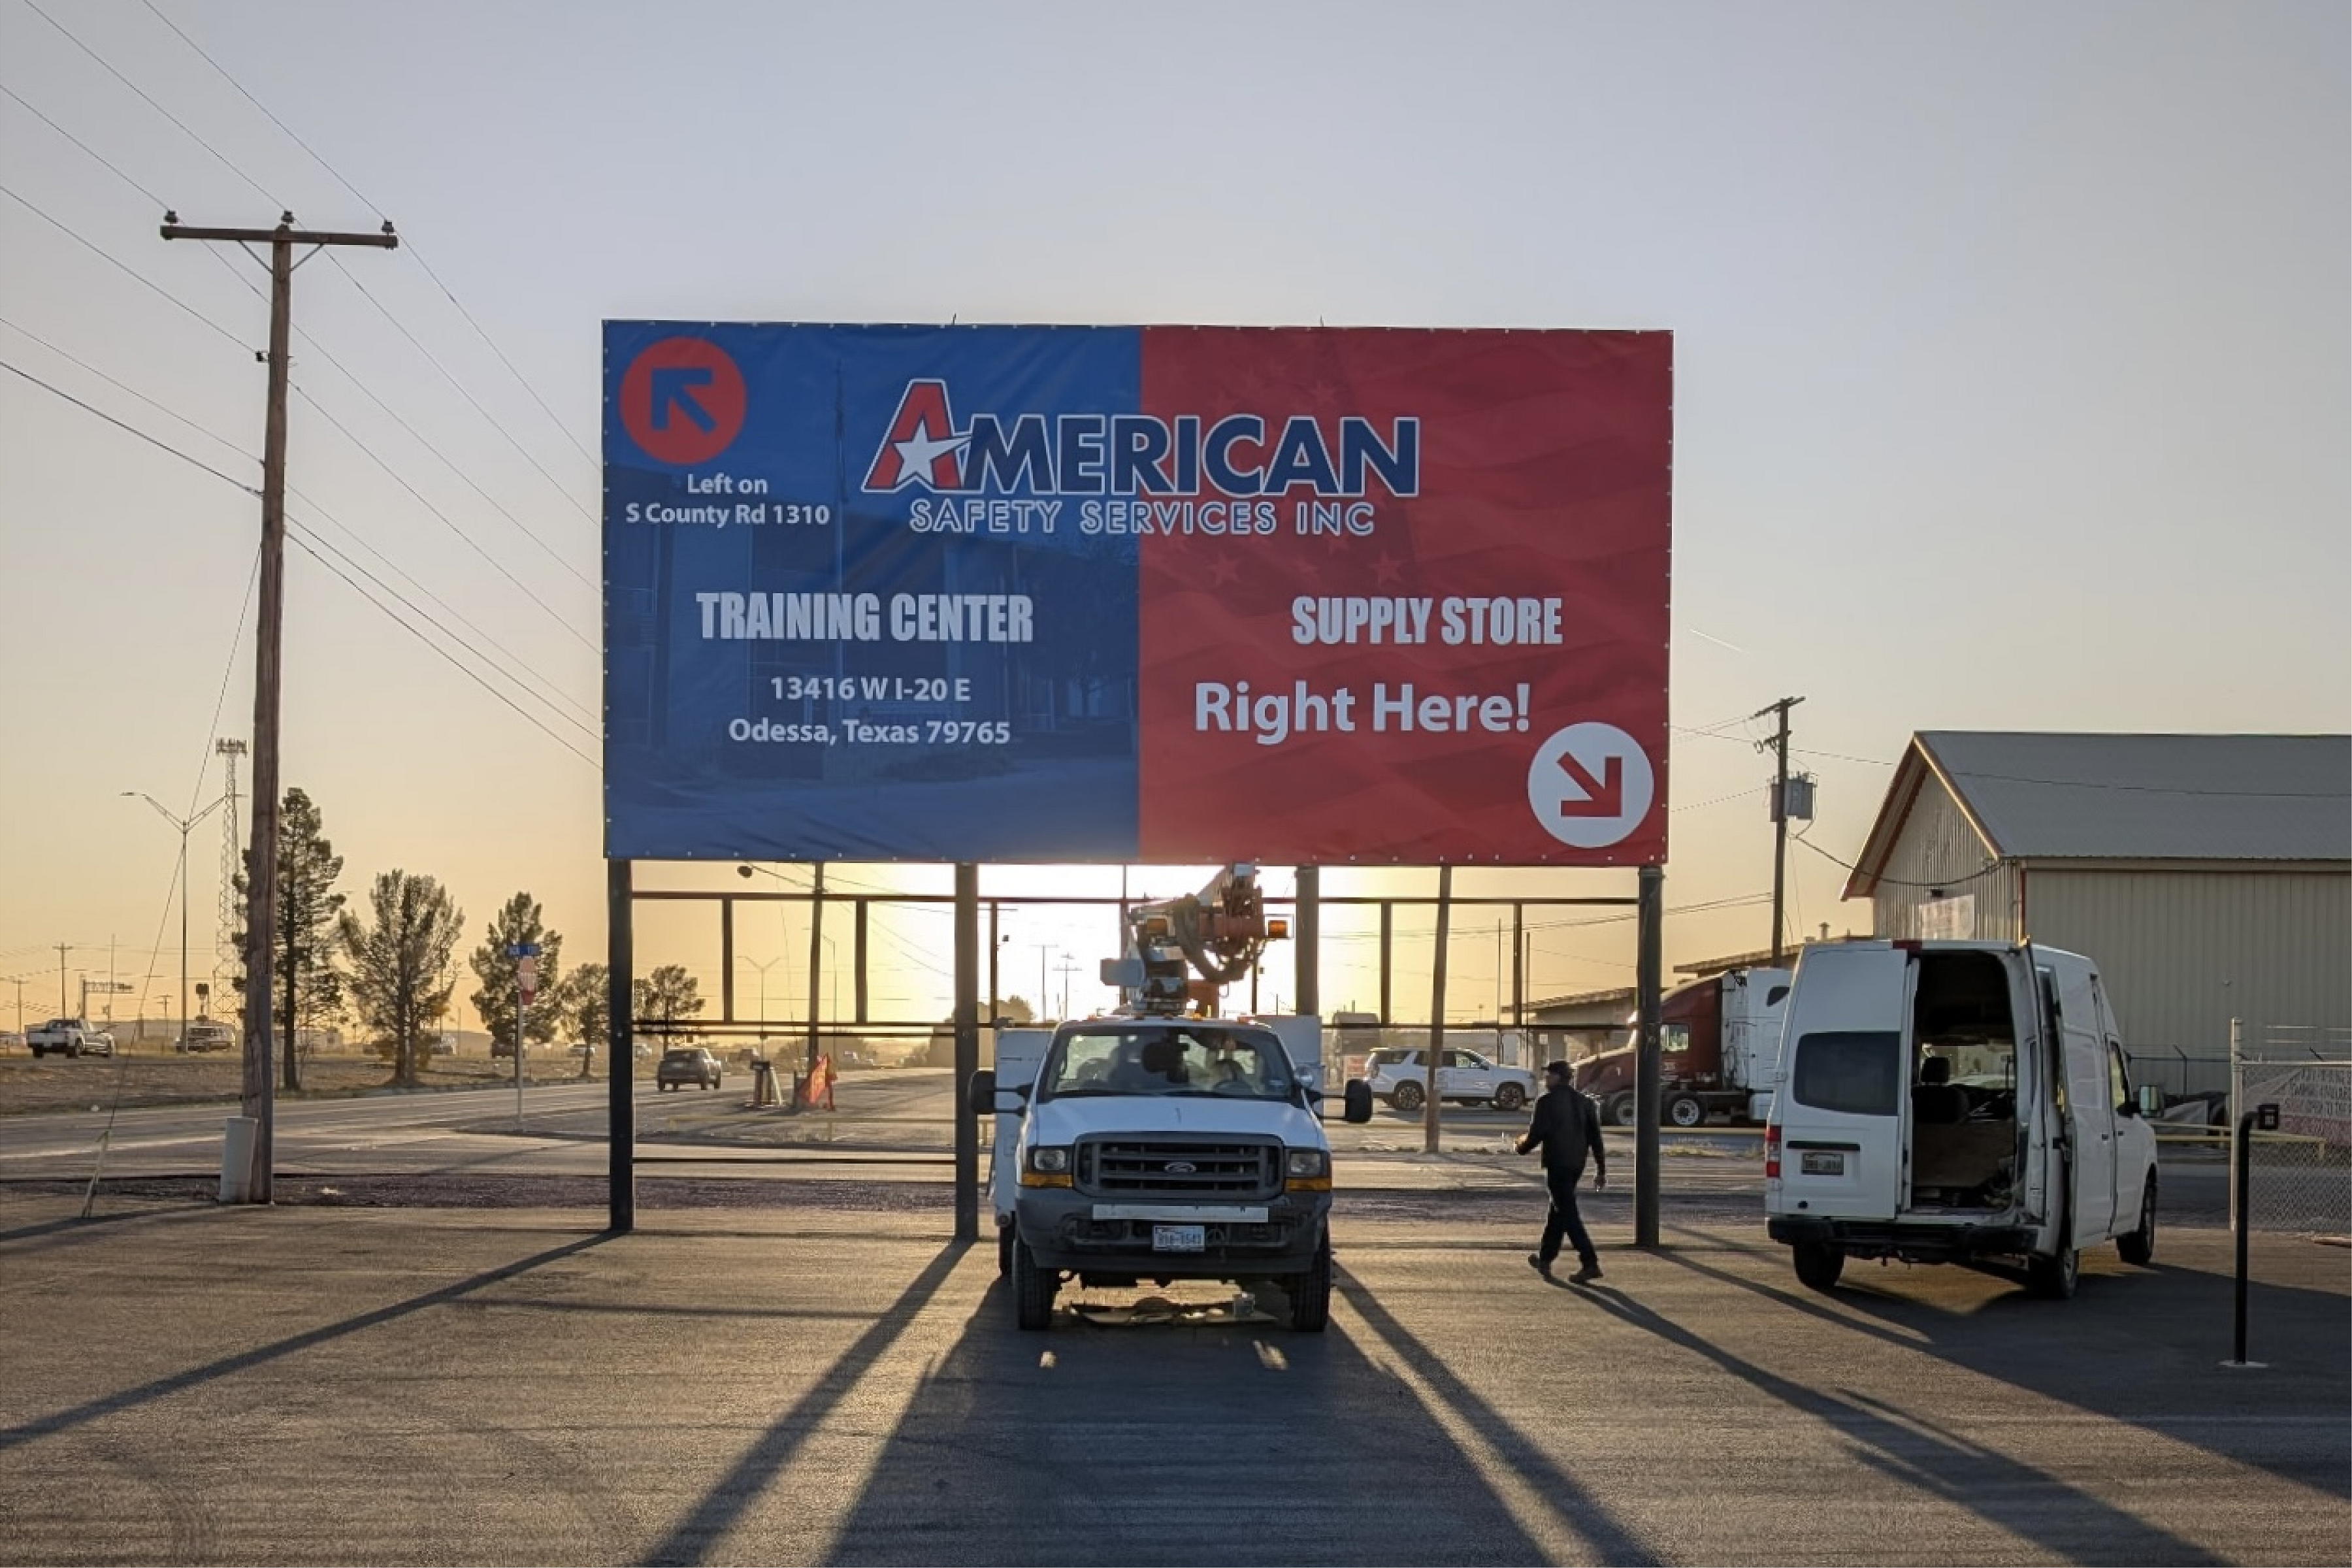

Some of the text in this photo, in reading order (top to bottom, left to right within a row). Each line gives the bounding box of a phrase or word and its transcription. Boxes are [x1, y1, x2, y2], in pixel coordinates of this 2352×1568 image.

[861, 378, 1420, 497] AMERICAN
[688, 472, 768, 493] Left on
[626, 503, 828, 528] S County Rd 1310
[910, 498, 1373, 536] SAFETY SERVICES INC
[696, 592, 1033, 642] TRAINING CENTER
[1292, 596, 1562, 645] SUPPLY STORE
[772, 677, 971, 701] 13416 W I-20 E
[729, 717, 1010, 745] Odessa, Texas 79765
[1196, 680, 1529, 745] Right Here!
